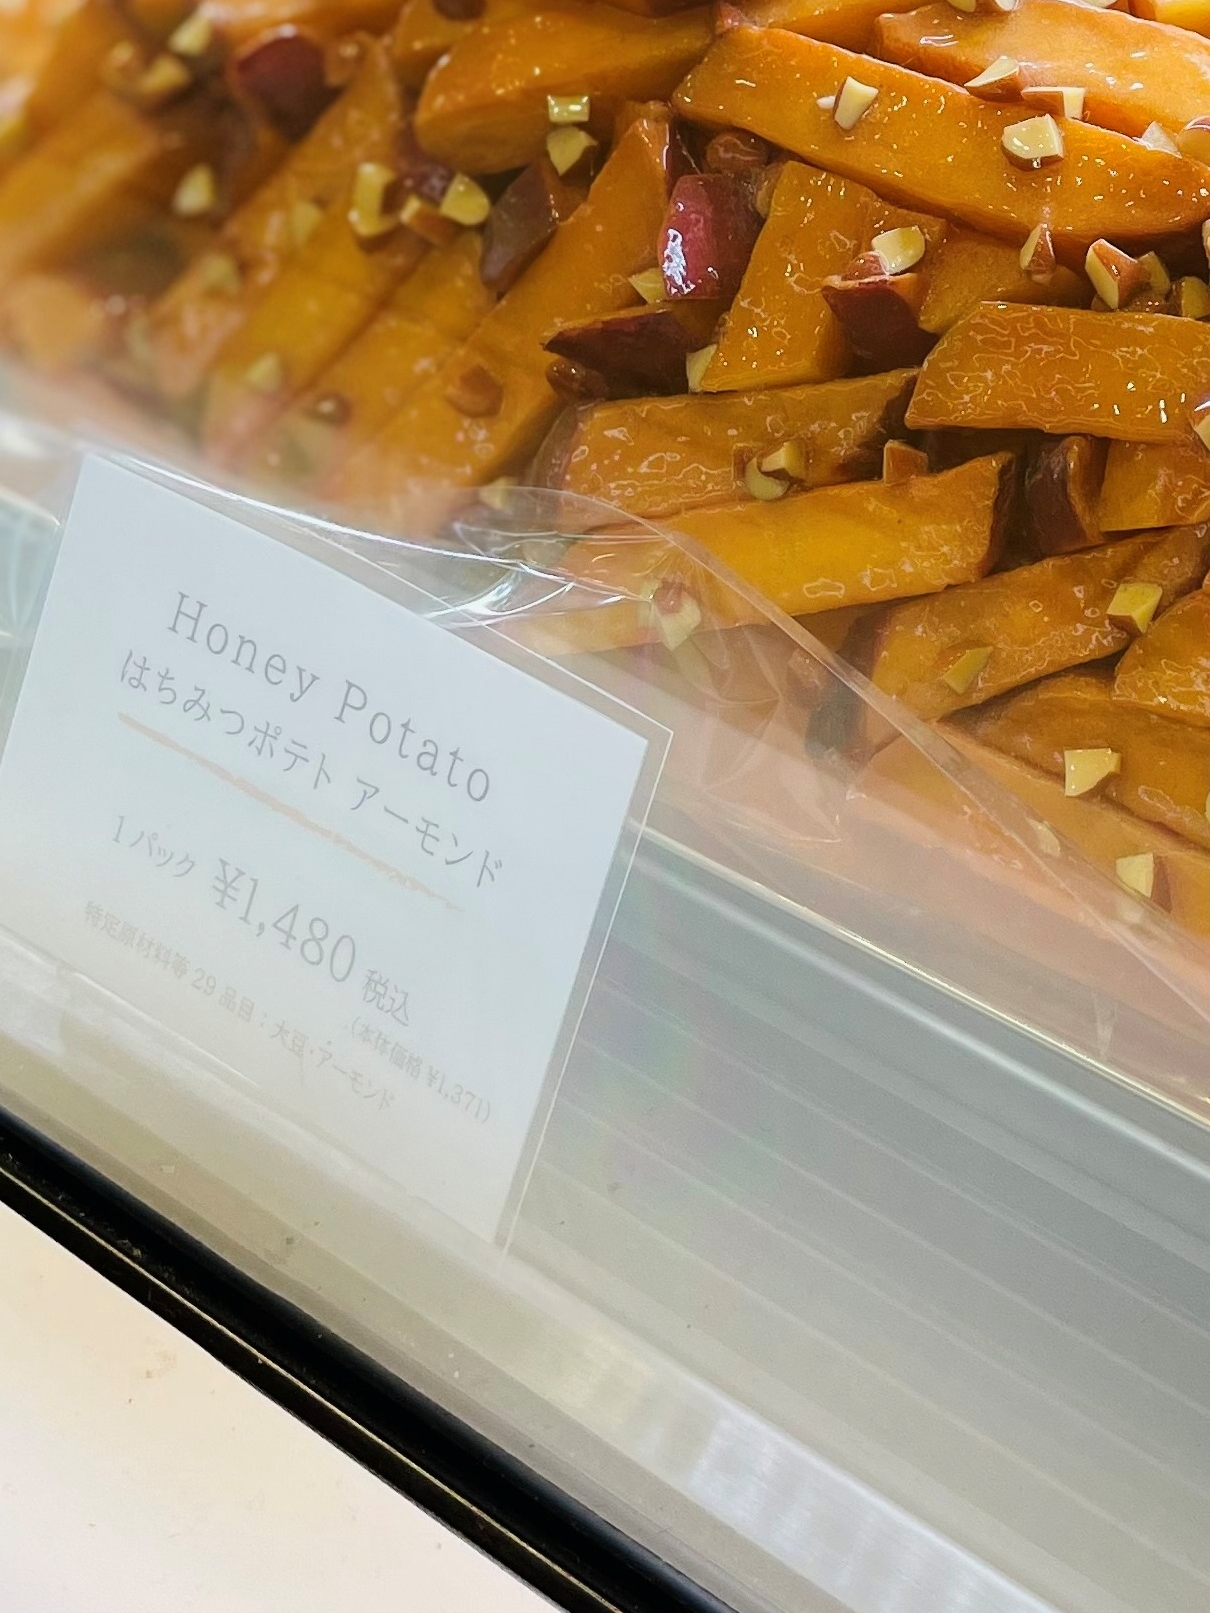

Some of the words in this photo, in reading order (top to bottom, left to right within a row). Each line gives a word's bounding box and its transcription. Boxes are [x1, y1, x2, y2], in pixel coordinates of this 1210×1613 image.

[119, 649, 331, 789] はちみつポテト
[350, 777, 503, 888] アーモンド
[167, 592, 319, 703] Honey
[333, 680, 490, 803] Potato
[211, 858, 357, 983] ¥1,480
